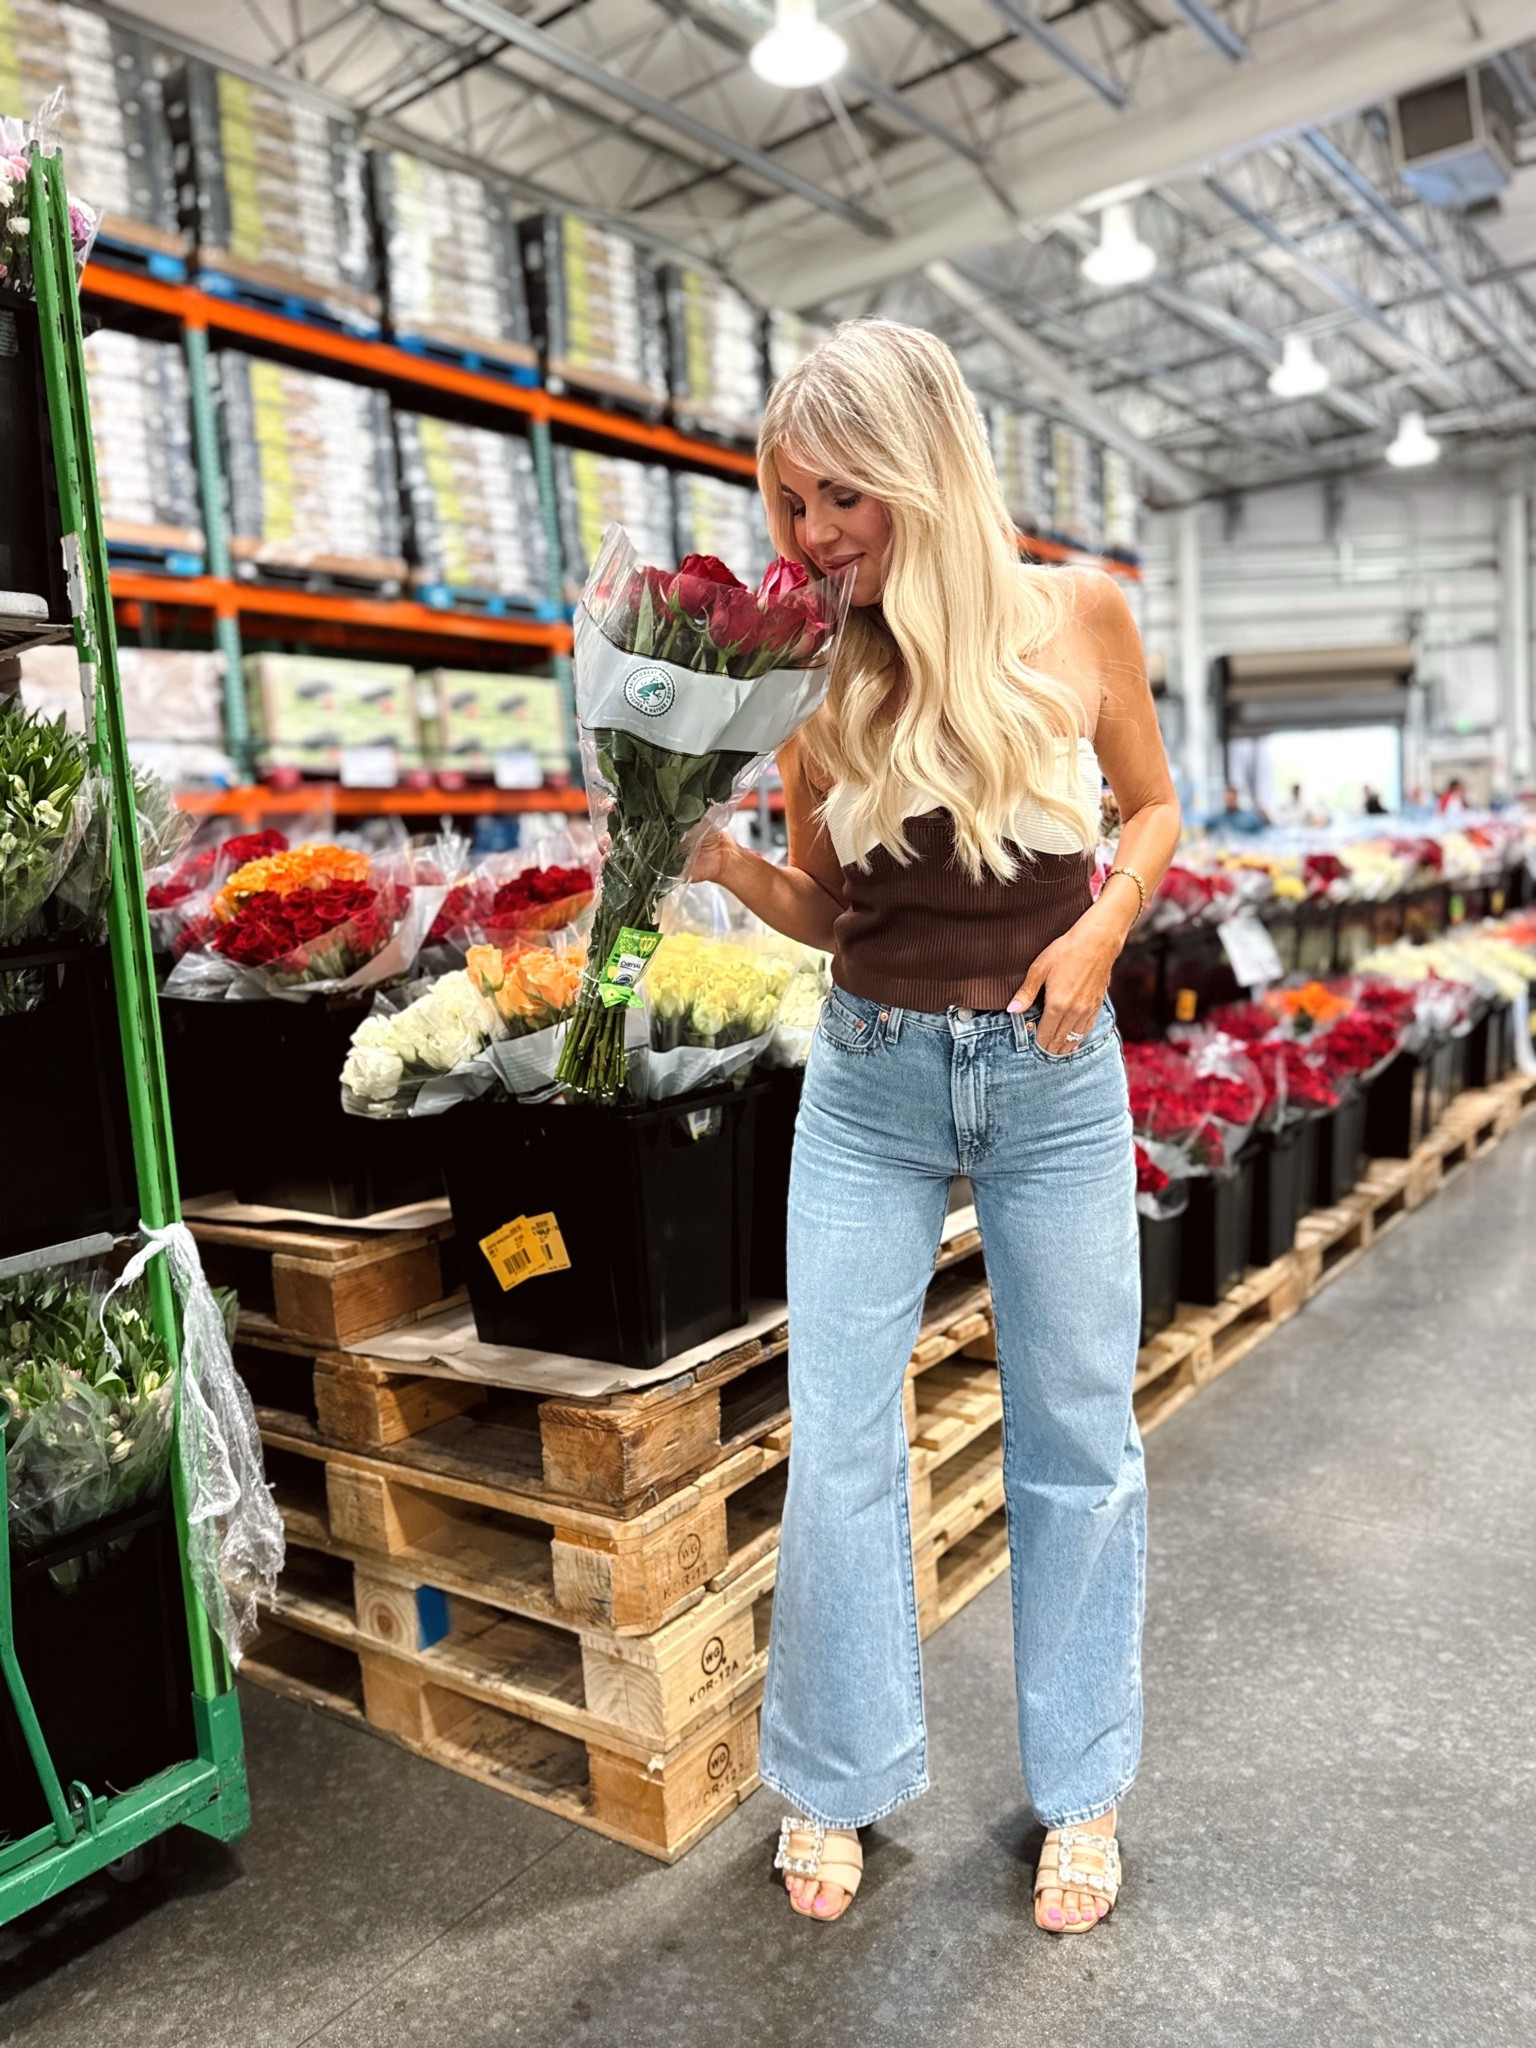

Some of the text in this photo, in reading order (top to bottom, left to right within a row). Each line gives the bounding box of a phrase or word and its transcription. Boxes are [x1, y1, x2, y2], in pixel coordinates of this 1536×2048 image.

[705, 1646, 720, 1664] WG
[689, 1660, 738, 1706] KOR-12A
[711, 1752, 726, 1770] WG
